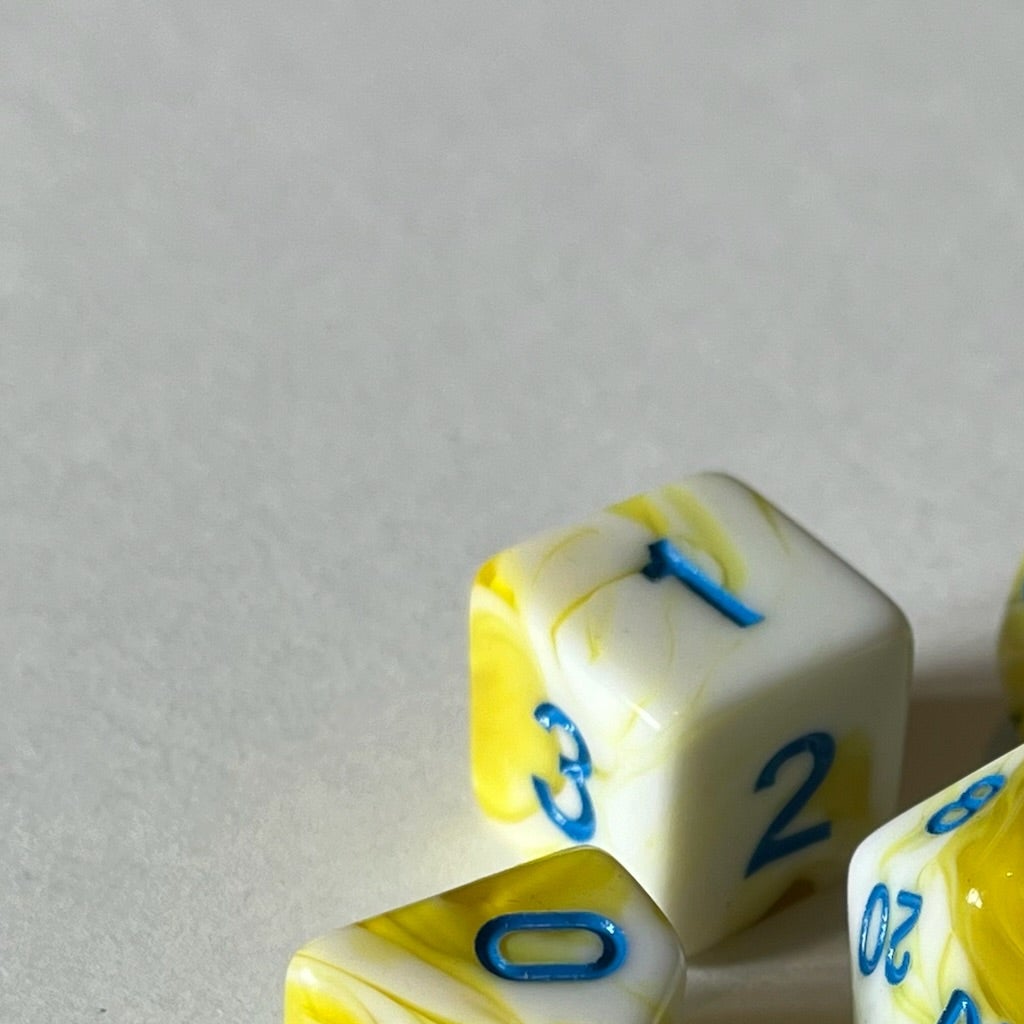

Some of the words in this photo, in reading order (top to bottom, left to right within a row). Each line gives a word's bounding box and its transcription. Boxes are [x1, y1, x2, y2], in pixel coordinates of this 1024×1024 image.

[640, 537, 766, 629] 1
[532, 701, 598, 841] 3
[744, 731, 836, 880] 2
[926, 773, 1006, 836] 8
[475, 911, 628, 982] 0
[858, 882, 923, 986] 20
